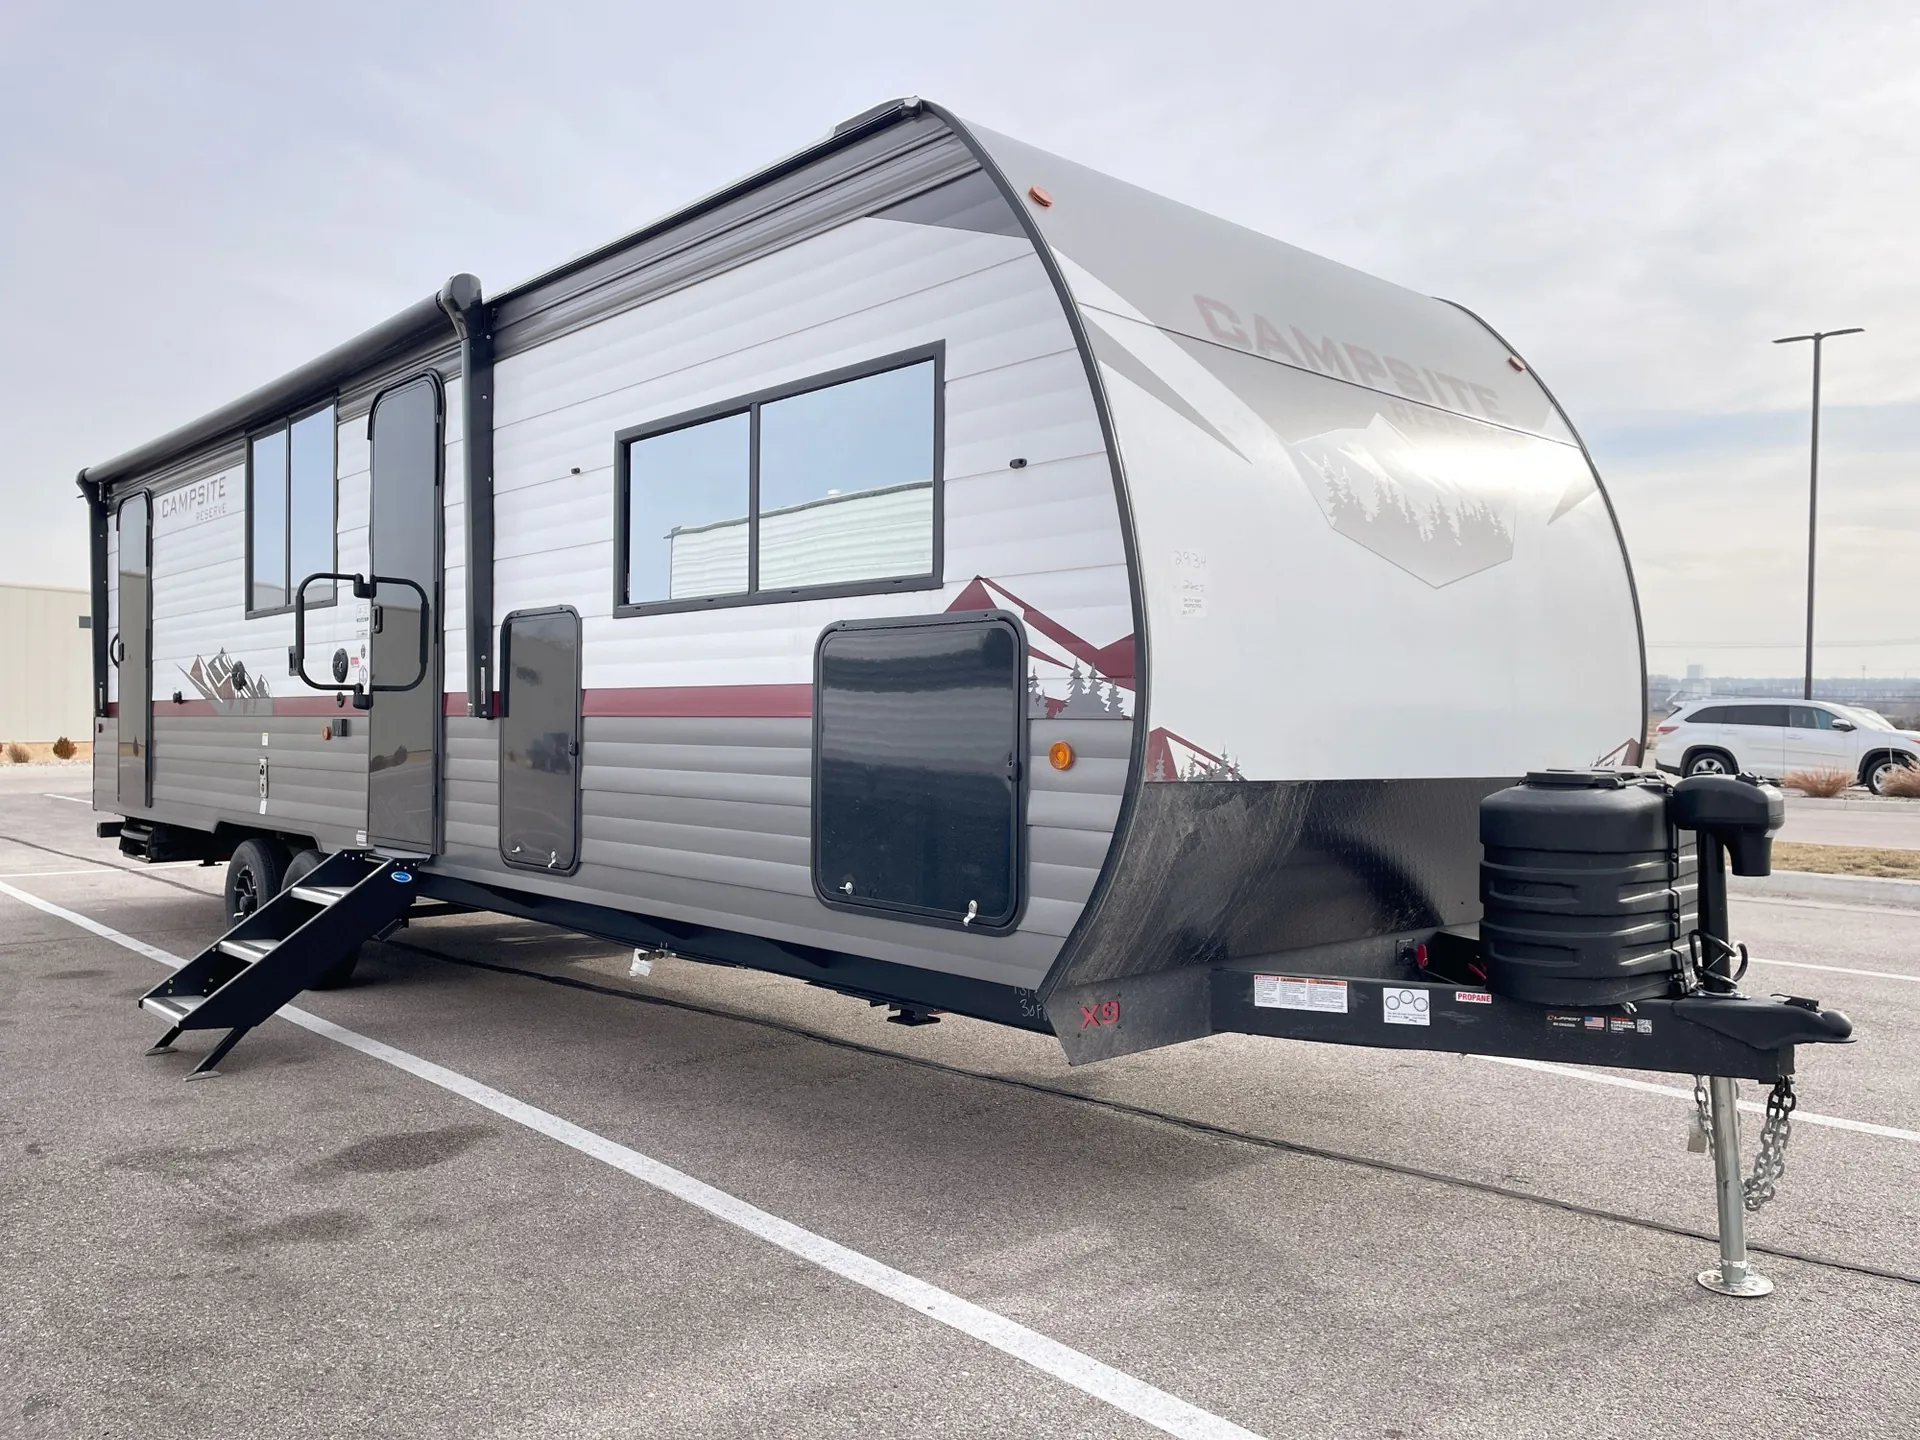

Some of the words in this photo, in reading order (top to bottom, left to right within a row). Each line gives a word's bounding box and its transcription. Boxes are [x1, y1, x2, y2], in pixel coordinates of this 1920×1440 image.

[1192, 294, 1515, 426] CAMPSITE
[162, 476, 226, 518] CAMPSITE
[196, 503, 227, 521] RESERVE
[1174, 549, 1207, 570] 2934
[1457, 993, 1492, 1003] PROPANE
[1080, 1000, 1120, 1030] X9
